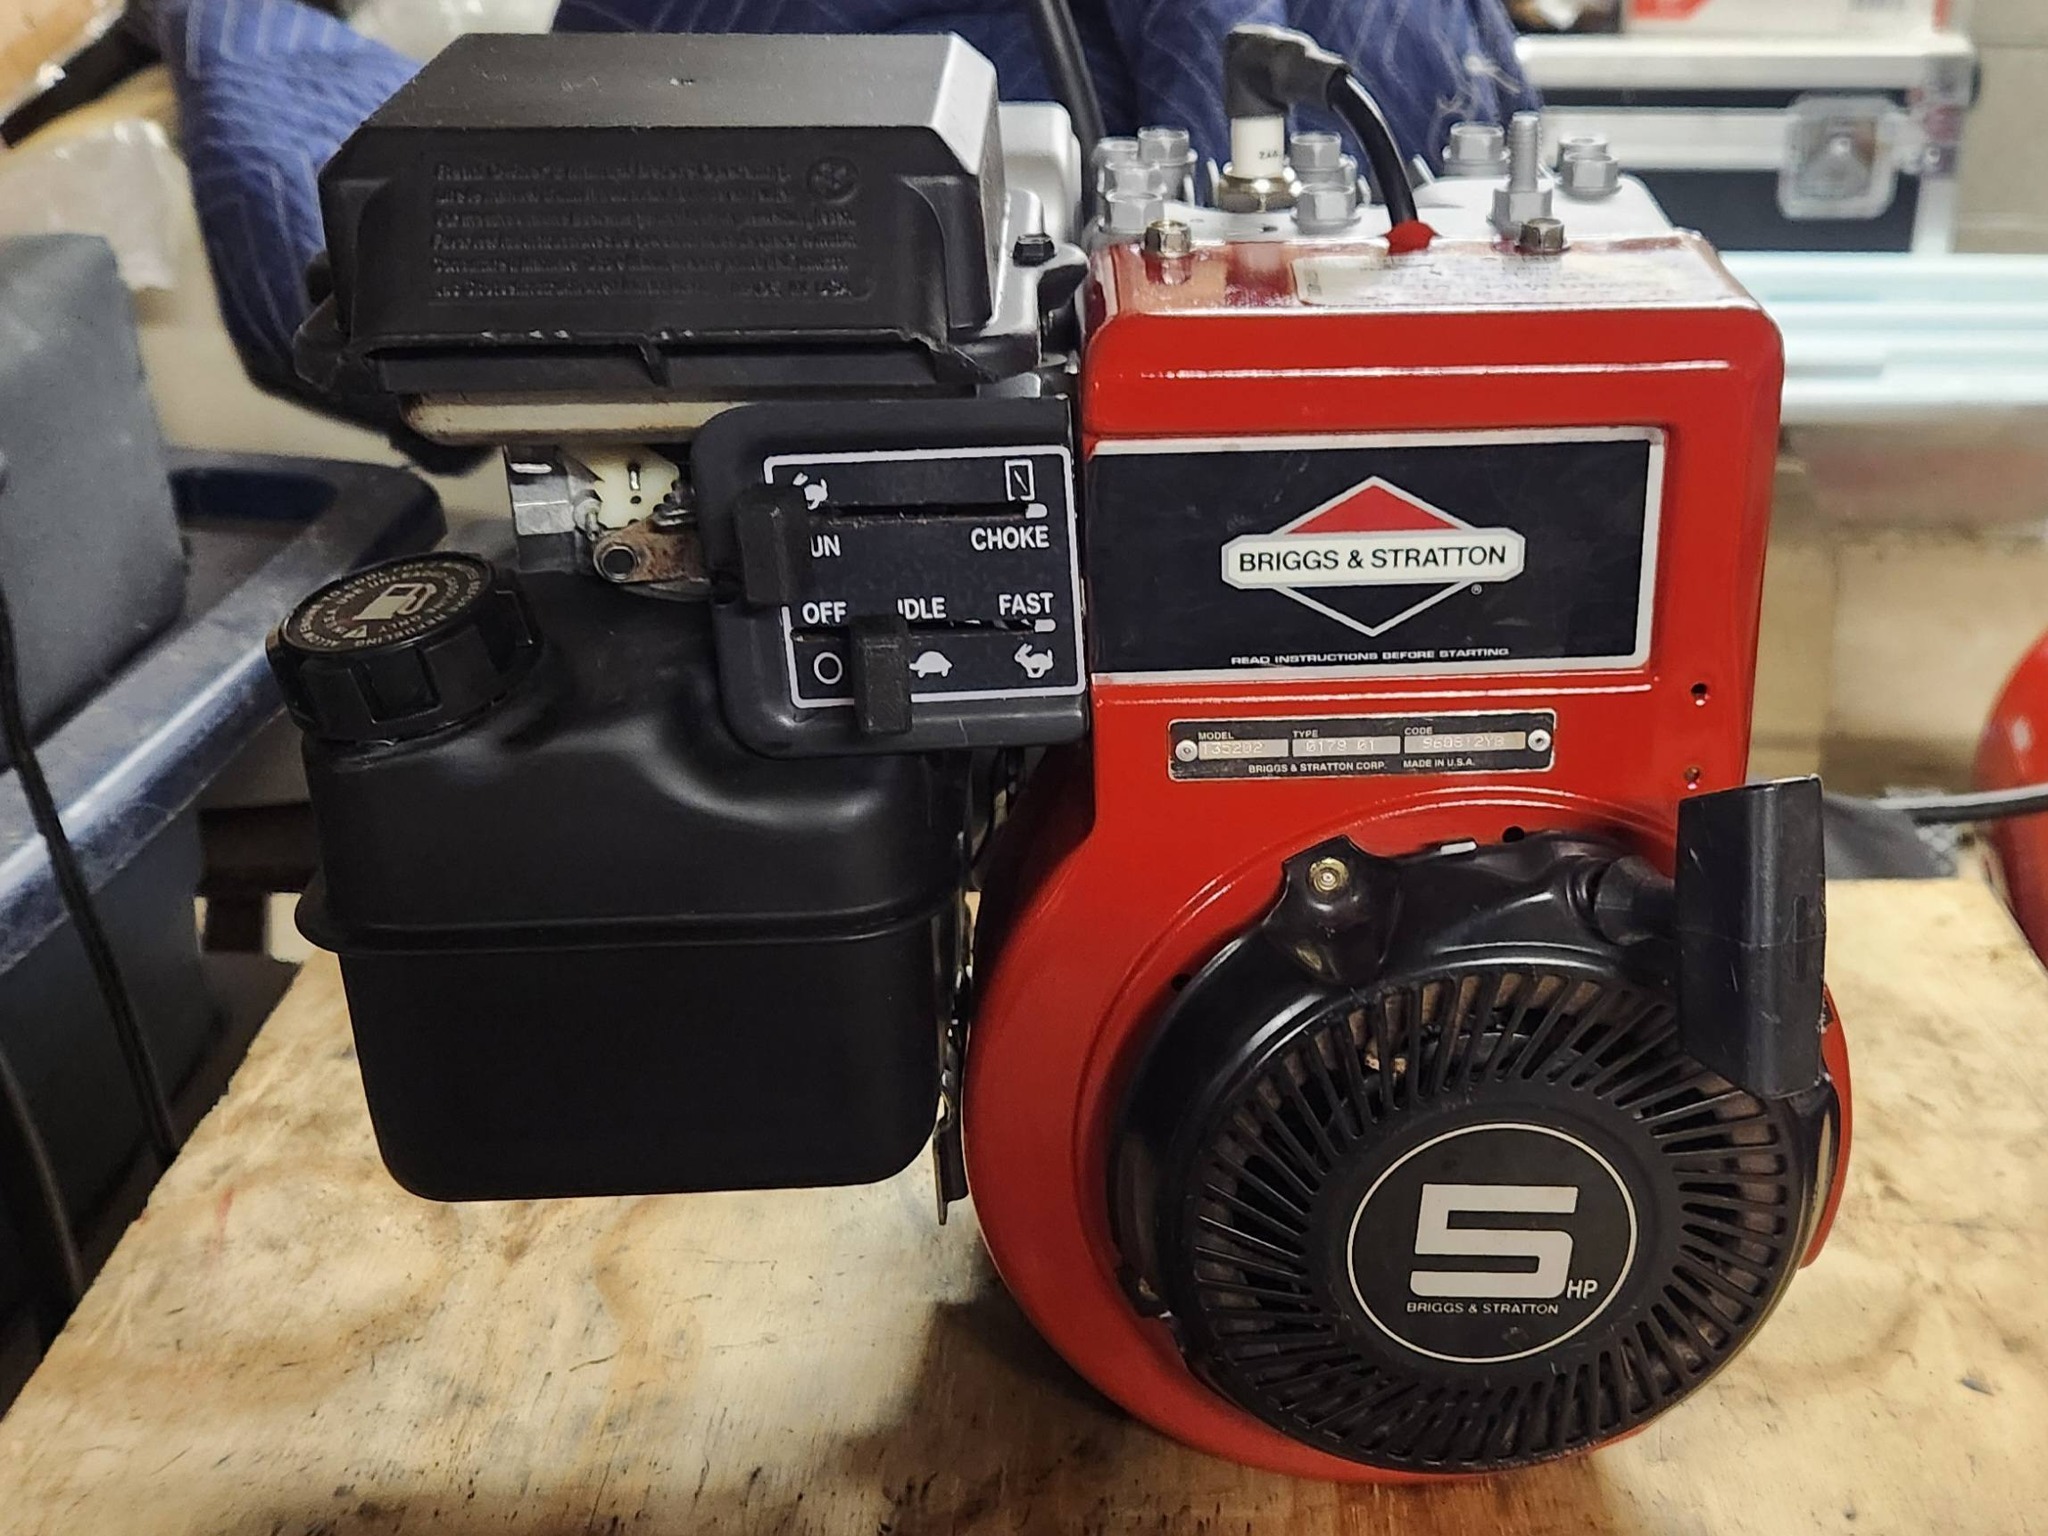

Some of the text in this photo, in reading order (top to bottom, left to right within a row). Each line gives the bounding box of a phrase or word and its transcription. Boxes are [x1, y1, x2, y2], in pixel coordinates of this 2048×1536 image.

[810, 534, 841, 558] UN
[970, 525, 1050, 551] CHOKE
[1239, 545, 1506, 573] BRIGGS & STRATTON
[802, 601, 847, 625] OFF
[897, 597, 947, 619] IDLE
[998, 592, 1054, 615] FAST
[1231, 648, 1510, 665] READ INSTRUCTIONS BEFORE STARTING
[1198, 731, 1234, 740] MODEL
[1293, 730, 1318, 739] TYPE
[1404, 726, 1433, 736] CODE
[1248, 761, 1387, 774] BRIGGS & STRATTON CORP.
[1403, 758, 1475, 768] MADE IN U.S.A.
[1410, 1183, 1578, 1299] 5
[1566, 1279, 1598, 1299] HP
[1406, 1302, 1559, 1315] BRIGGS & STRATTON
